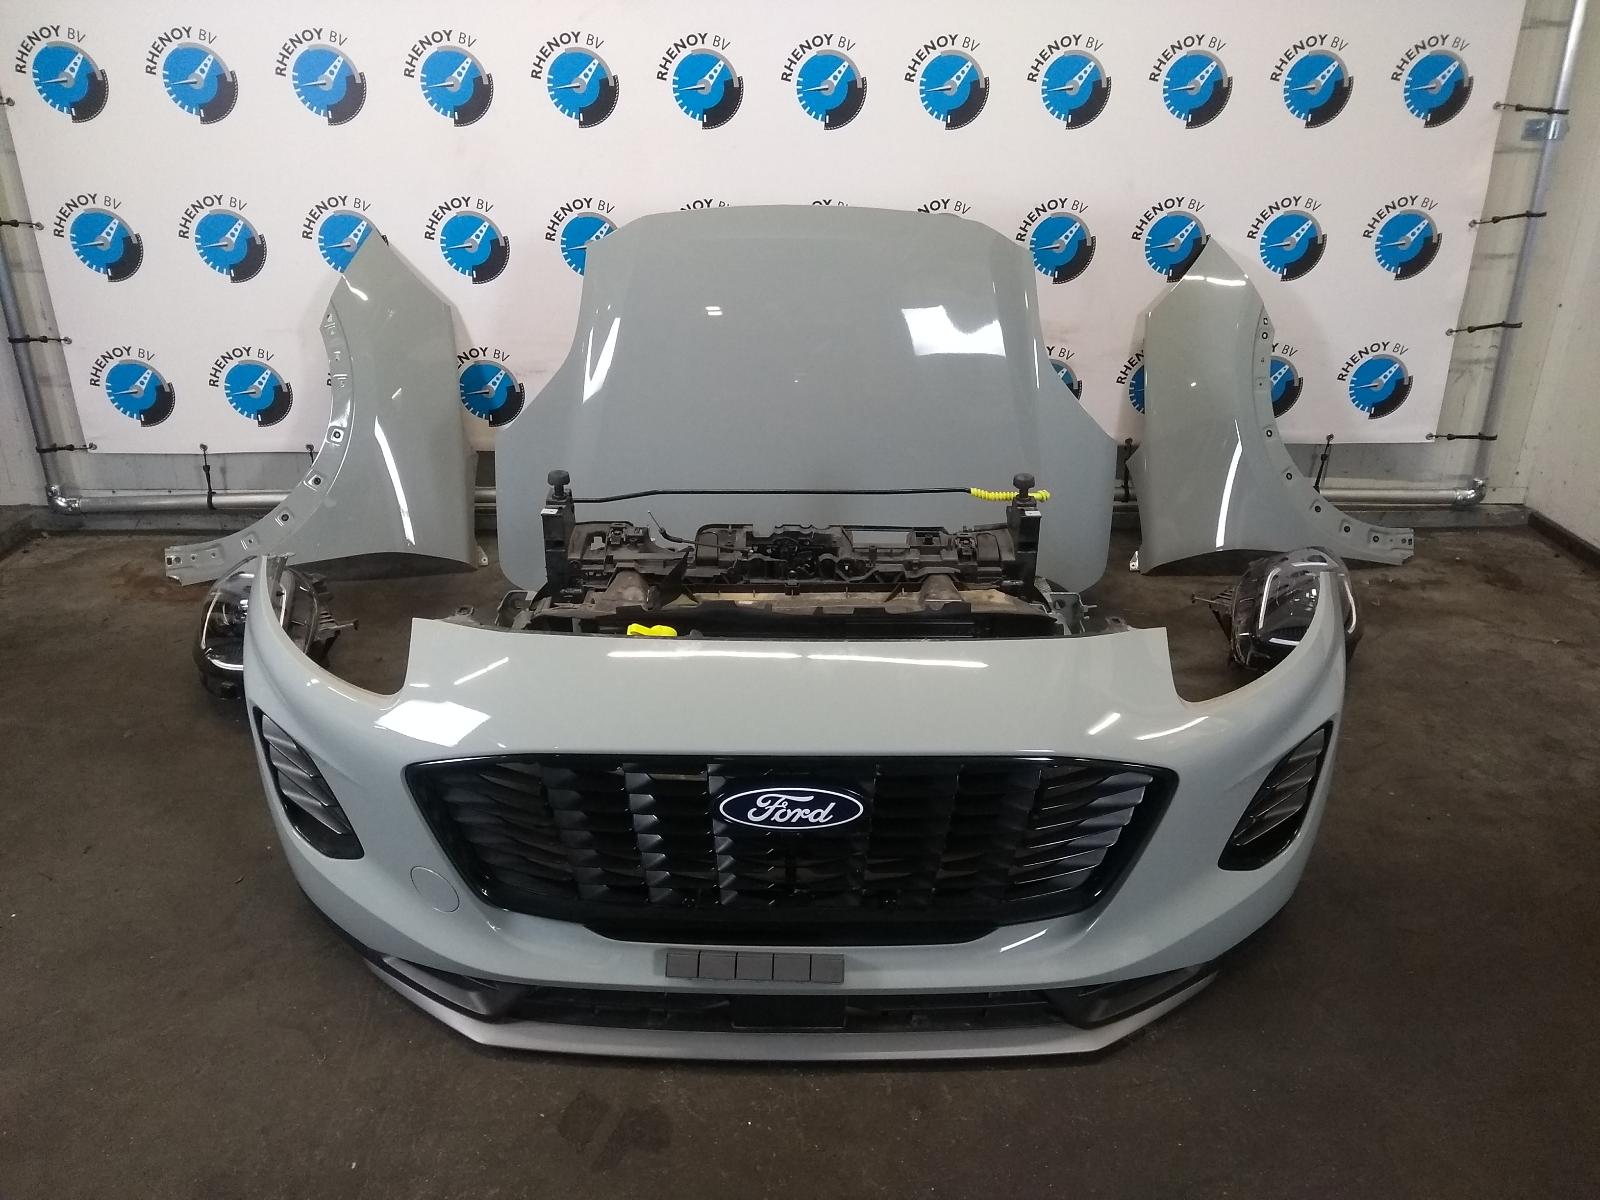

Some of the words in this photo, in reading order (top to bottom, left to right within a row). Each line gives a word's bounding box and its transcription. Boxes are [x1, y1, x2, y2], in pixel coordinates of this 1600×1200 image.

[15, 25, 60, 74] RHENOY
[68, 28, 86, 43] BV
[146, 26, 192, 75] RHENOY
[199, 29, 216, 44] BV
[275, 28, 322, 77] RHENOY
[330, 31, 347, 46] BV
[404, 30, 452, 78] RHENOY
[458, 32, 476, 47] BV
[531, 32, 580, 80] RHENOY
[586, 34, 604, 49] BV
[657, 33, 708, 81] RHENOY
[713, 35, 730, 50] BV
[781, 34, 834, 82] RHENOY
[838, 36, 856, 51] BV
[904, 34, 958, 82] RHENOY
[962, 36, 980, 51] BV
[1027, 34, 1082, 82] RHENOY
[1086, 37, 1103, 52] BV
[1149, 34, 1205, 82] RHENOY
[1208, 36, 1226, 51] BV
[1270, 34, 1328, 82] RHENOY
[1330, 36, 1348, 51] BV
[1391, 34, 1449, 82] RHENOY
[1452, 37, 1470, 51] BV
[53, 194, 97, 238] RHENOY
[104, 196, 121, 209] BV
[178, 195, 223, 239] RHENOY
[230, 197, 247, 211] BV
[302, 196, 348, 240] RHENOY
[354, 198, 371, 211] BV
[424, 196, 471, 240] RHENOY
[476, 199, 493, 212] BV
[545, 198, 592, 241] RHENOY
[598, 200, 615, 214] BV
[917, 199, 950, 213] NOY
[954, 201, 971, 214] BV
[1016, 198, 1068, 242] RHENOY
[1071, 200, 1088, 213] BV
[1131, 197, 1185, 240] RHENOY
[1188, 199, 1205, 212] BV
[1247, 196, 1302, 239] RHENOY
[1304, 198, 1322, 212] BV
[1362, 195, 1418, 238] RHENOY
[1421, 197, 1438, 210] BV
[90, 346, 132, 386] RHENOY
[138, 348, 155, 361] BV
[209, 347, 252, 387] RHENOY
[258, 348, 274, 361] BV
[457, 347, 488, 369] NOY
[493, 349, 510, 362] BV
[1058, 347, 1075, 360] BV
[1116, 350, 1144, 385] RHEN
[1281, 344, 1298, 357] BV
[1337, 341, 1390, 381] RHENOY
[1392, 343, 1408, 355] BV
[747, 793, 837, 823] Ford
